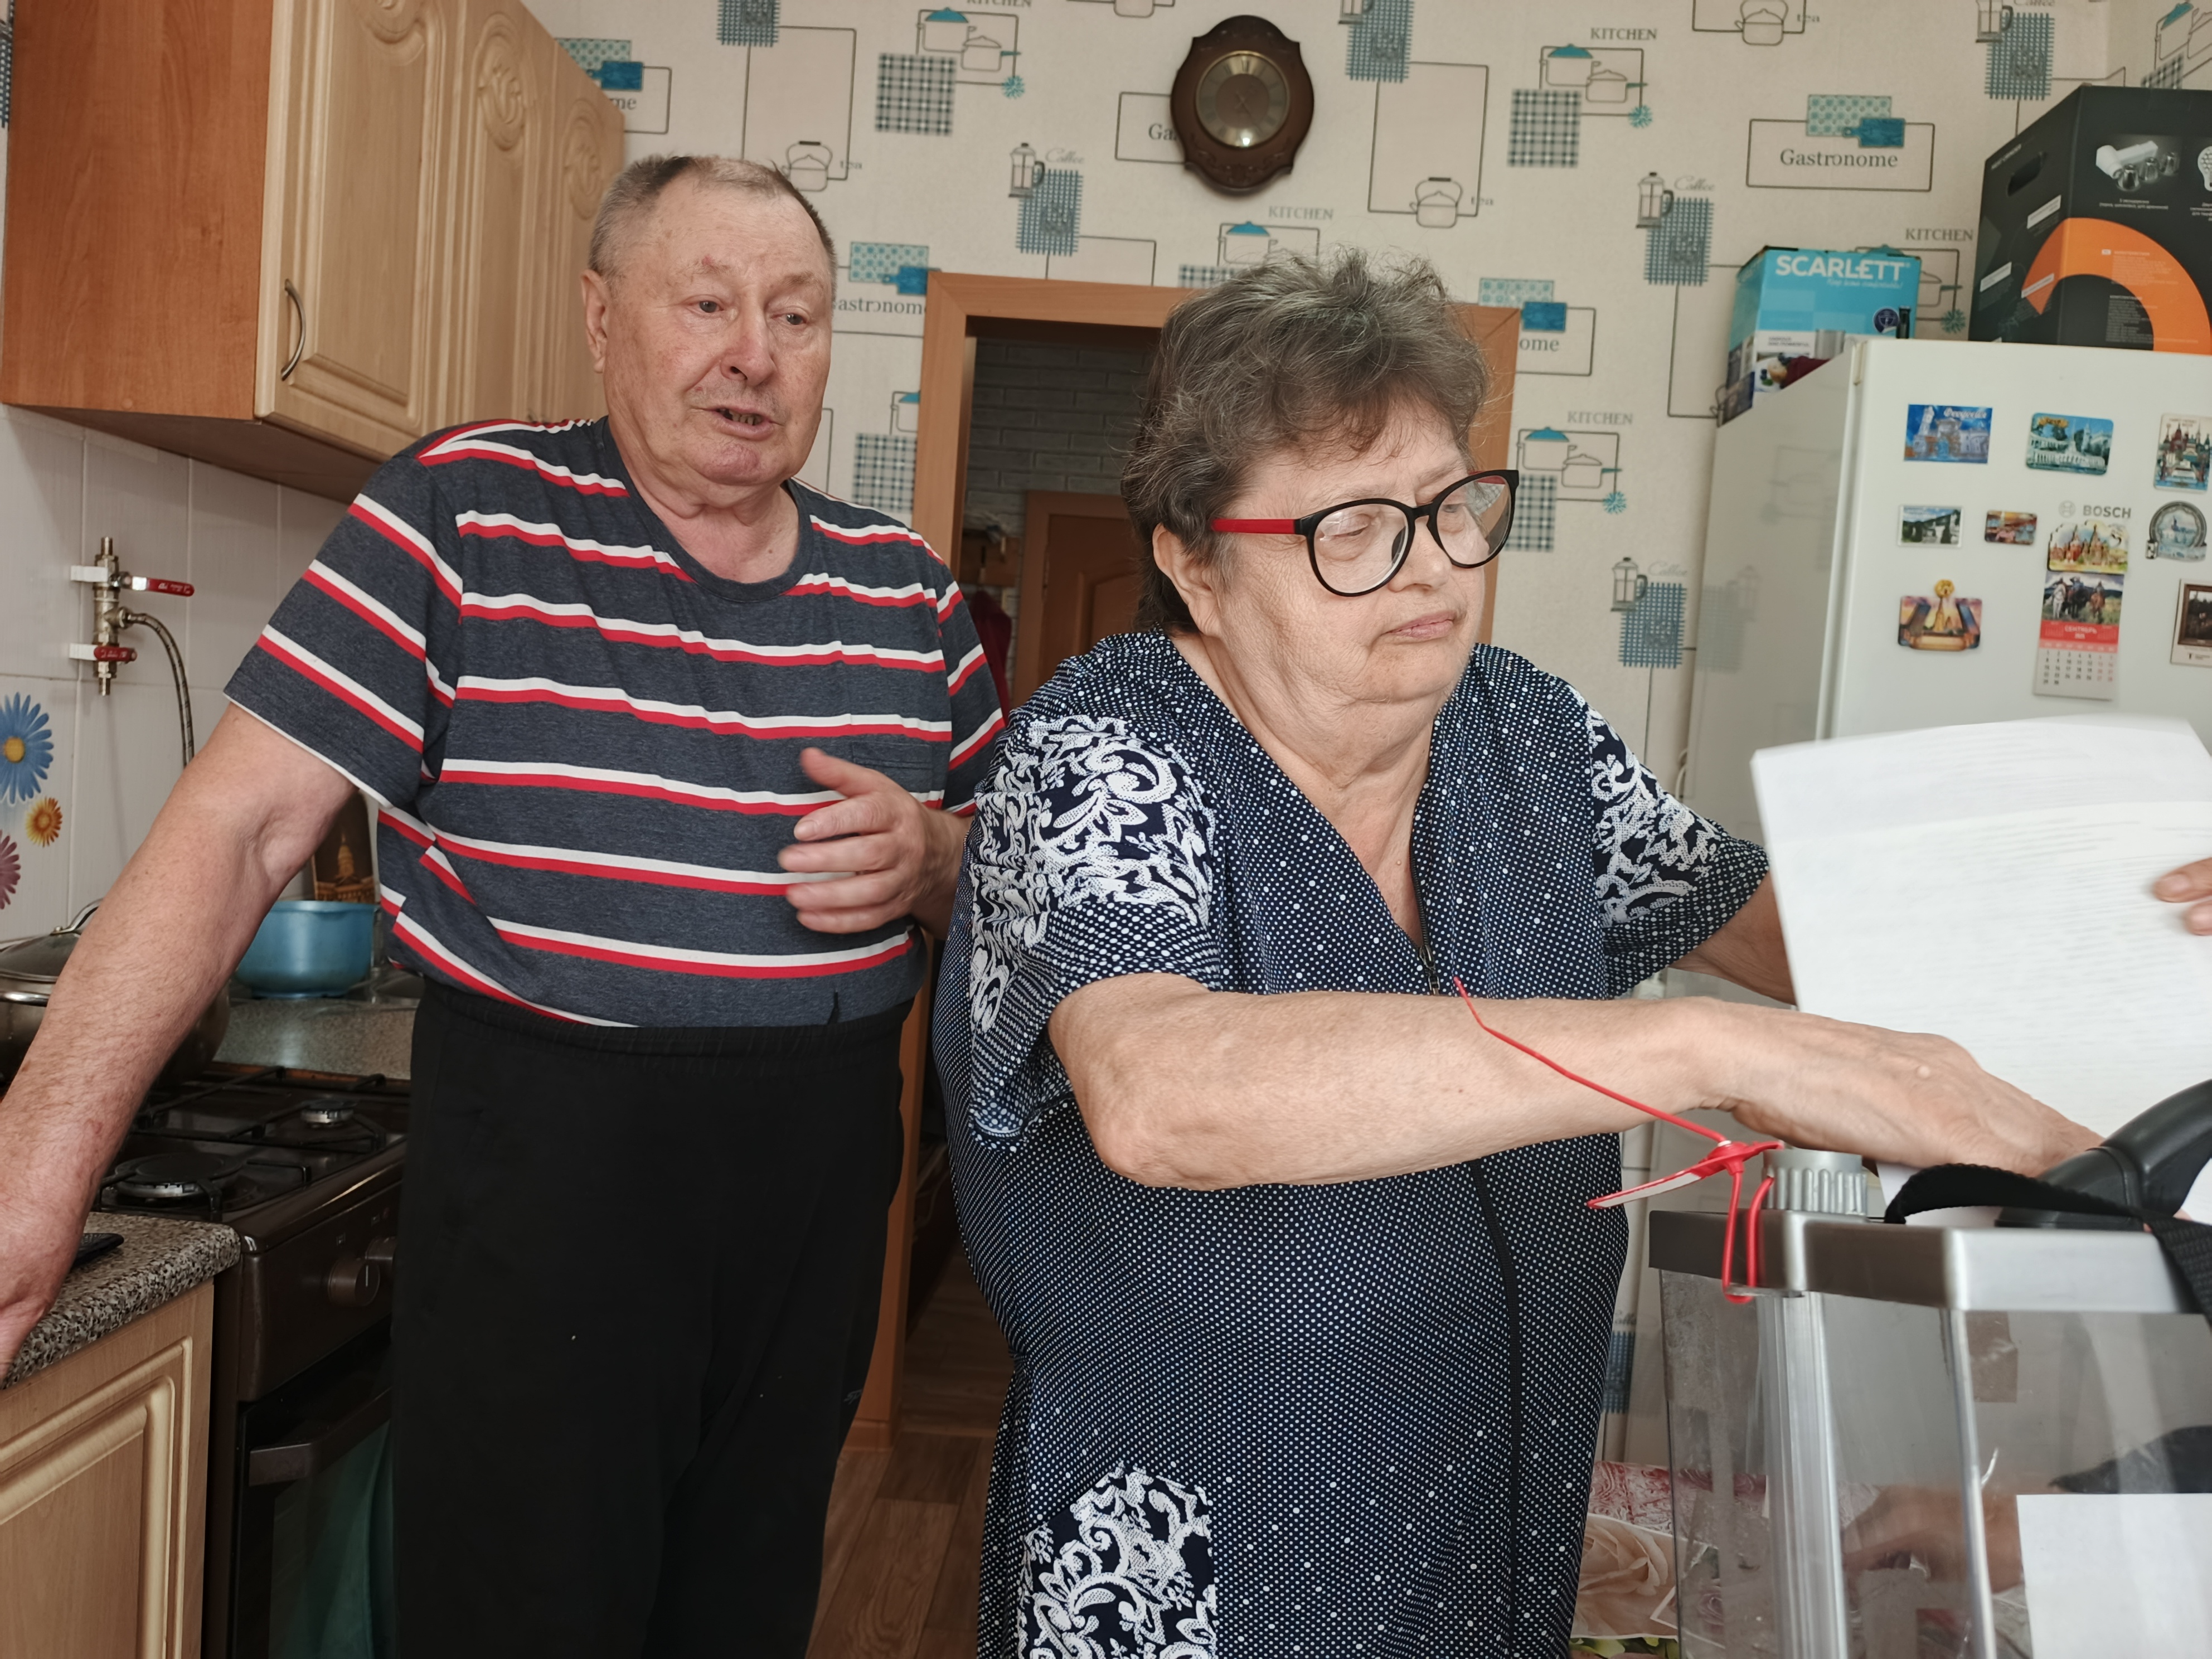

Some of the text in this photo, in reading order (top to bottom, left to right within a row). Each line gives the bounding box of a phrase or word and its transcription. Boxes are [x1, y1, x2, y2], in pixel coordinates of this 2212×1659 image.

[1590, 27, 1658, 41] KITCHEN
[1779, 148, 1899, 169] Gastronome
[1268, 205, 1334, 220] KITCHEN
[1905, 227, 1974, 242] KITCHEN
[1776, 255, 1906, 281] SCARLETT
[832, 298, 927, 316] astronom
[1567, 411, 1633, 425] KITCHEN
[2083, 504, 2132, 519] BOSCH
